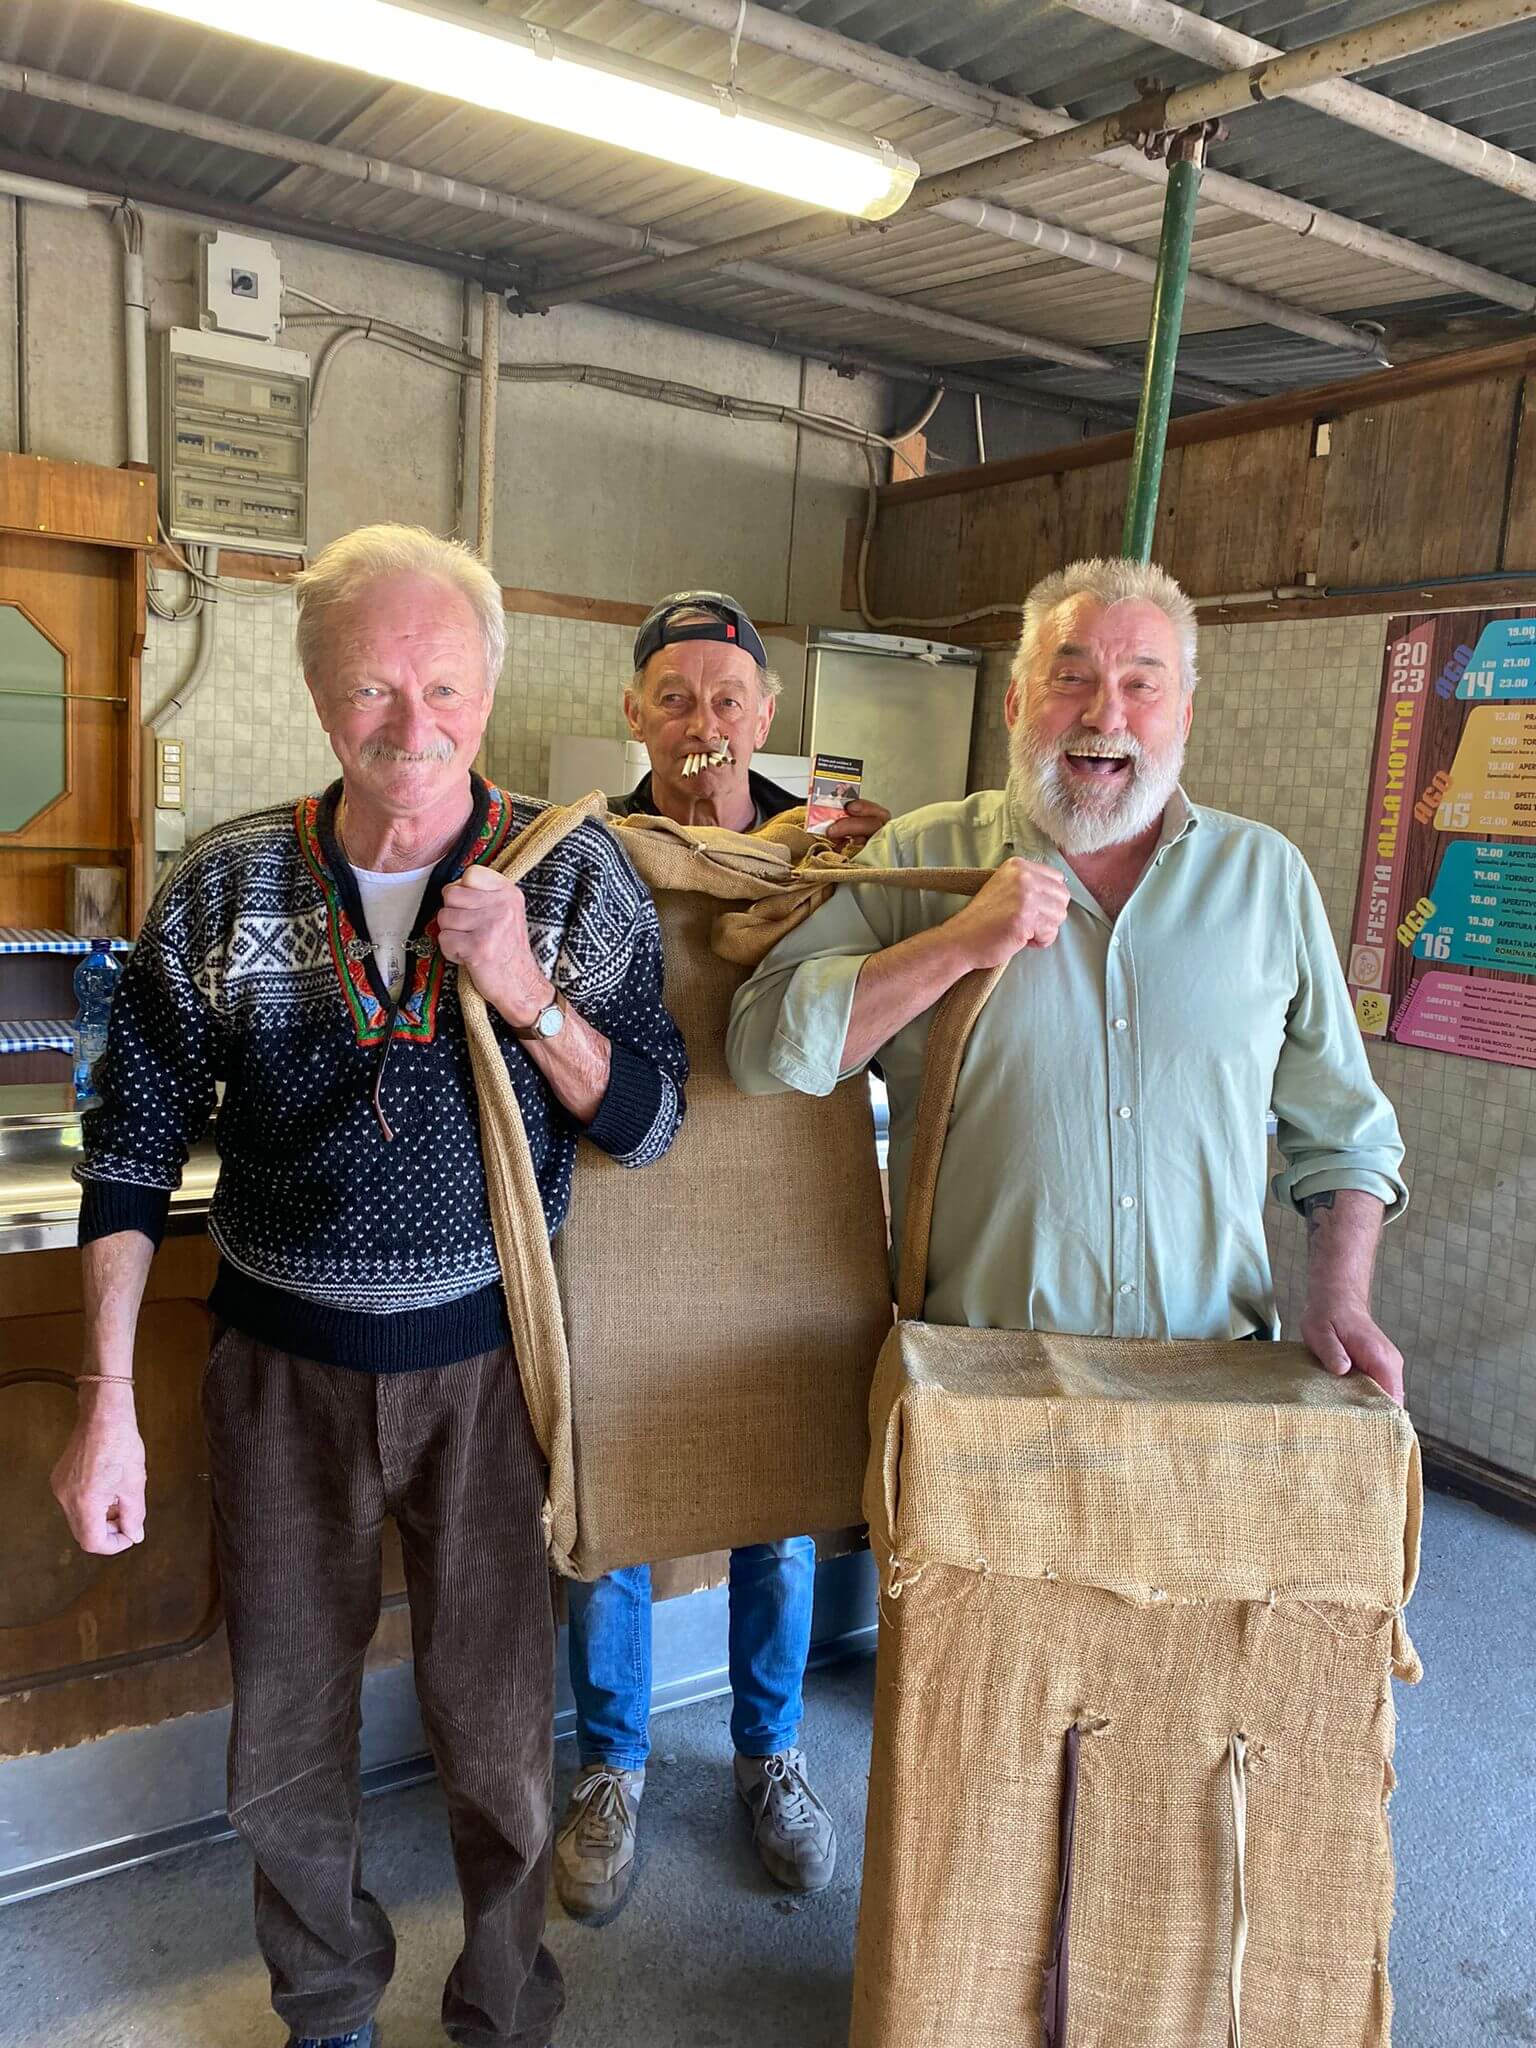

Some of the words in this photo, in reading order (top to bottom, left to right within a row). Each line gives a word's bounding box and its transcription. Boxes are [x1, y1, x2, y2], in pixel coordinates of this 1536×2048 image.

[1393, 641, 1428, 666] 20
[1502, 657, 1531, 668] 21.00
[1391, 669, 1425, 694] 23
[1435, 644, 1474, 699] AGO
[1463, 671, 1495, 697] 14
[1499, 678, 1529, 688] 23.00
[1385, 700, 1415, 789] MOTTA
[1414, 770, 1452, 824] AGO
[1377, 795, 1402, 858] ALLA
[1439, 801, 1472, 828] 15
[1475, 847, 1503, 858] 12.00
[1473, 870, 1501, 881] 14.00
[1366, 864, 1392, 944] FESTA
[1470, 895, 1497, 906] 18.00
[1397, 897, 1437, 947] AGO
[1421, 933, 1452, 960] 16
[1465, 932, 1492, 944] 21.00
